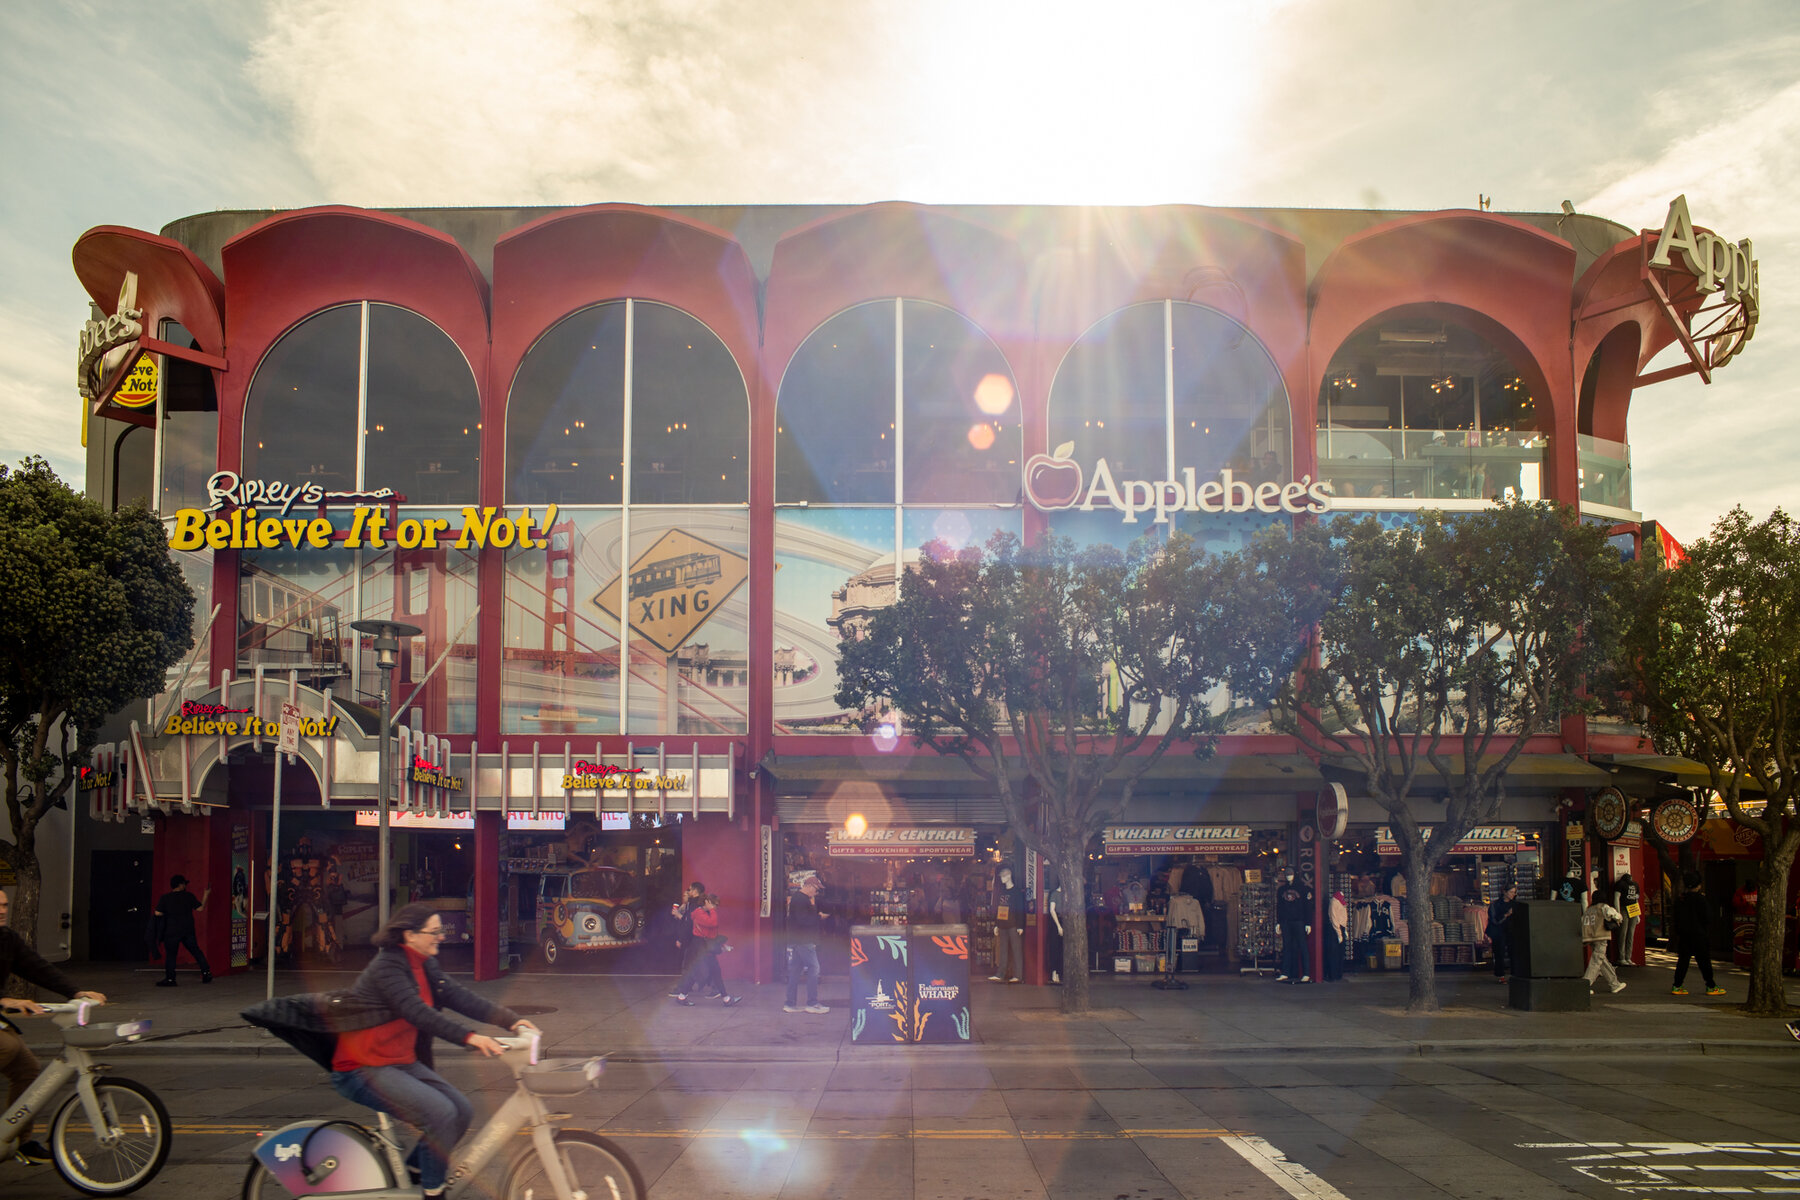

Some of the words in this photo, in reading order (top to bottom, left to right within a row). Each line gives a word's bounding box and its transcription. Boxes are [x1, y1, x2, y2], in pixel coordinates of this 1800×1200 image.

[128, 378, 158, 392] Not!
[1079, 458, 1333, 523] Applebee's
[169, 508, 333, 551] Believe
[344, 507, 387, 549] It
[396, 518, 449, 549] or
[455, 503, 559, 550] Not!
[640, 589, 710, 624] XING
[164, 715, 238, 736] Believe
[242, 716, 263, 736] It
[298, 715, 338, 737] Not!
[561, 774, 616, 789] Believe
[617, 774, 633, 789] It
[634, 778, 652, 789] or
[653, 774, 687, 790] Not!
[899, 830, 967, 841] CENTRAL
[1114, 828, 1171, 840] WHARF
[1175, 828, 1241, 840] CENTRAL
[919, 991, 959, 1000] WHARF
[7, 1105, 31, 1125] bay
